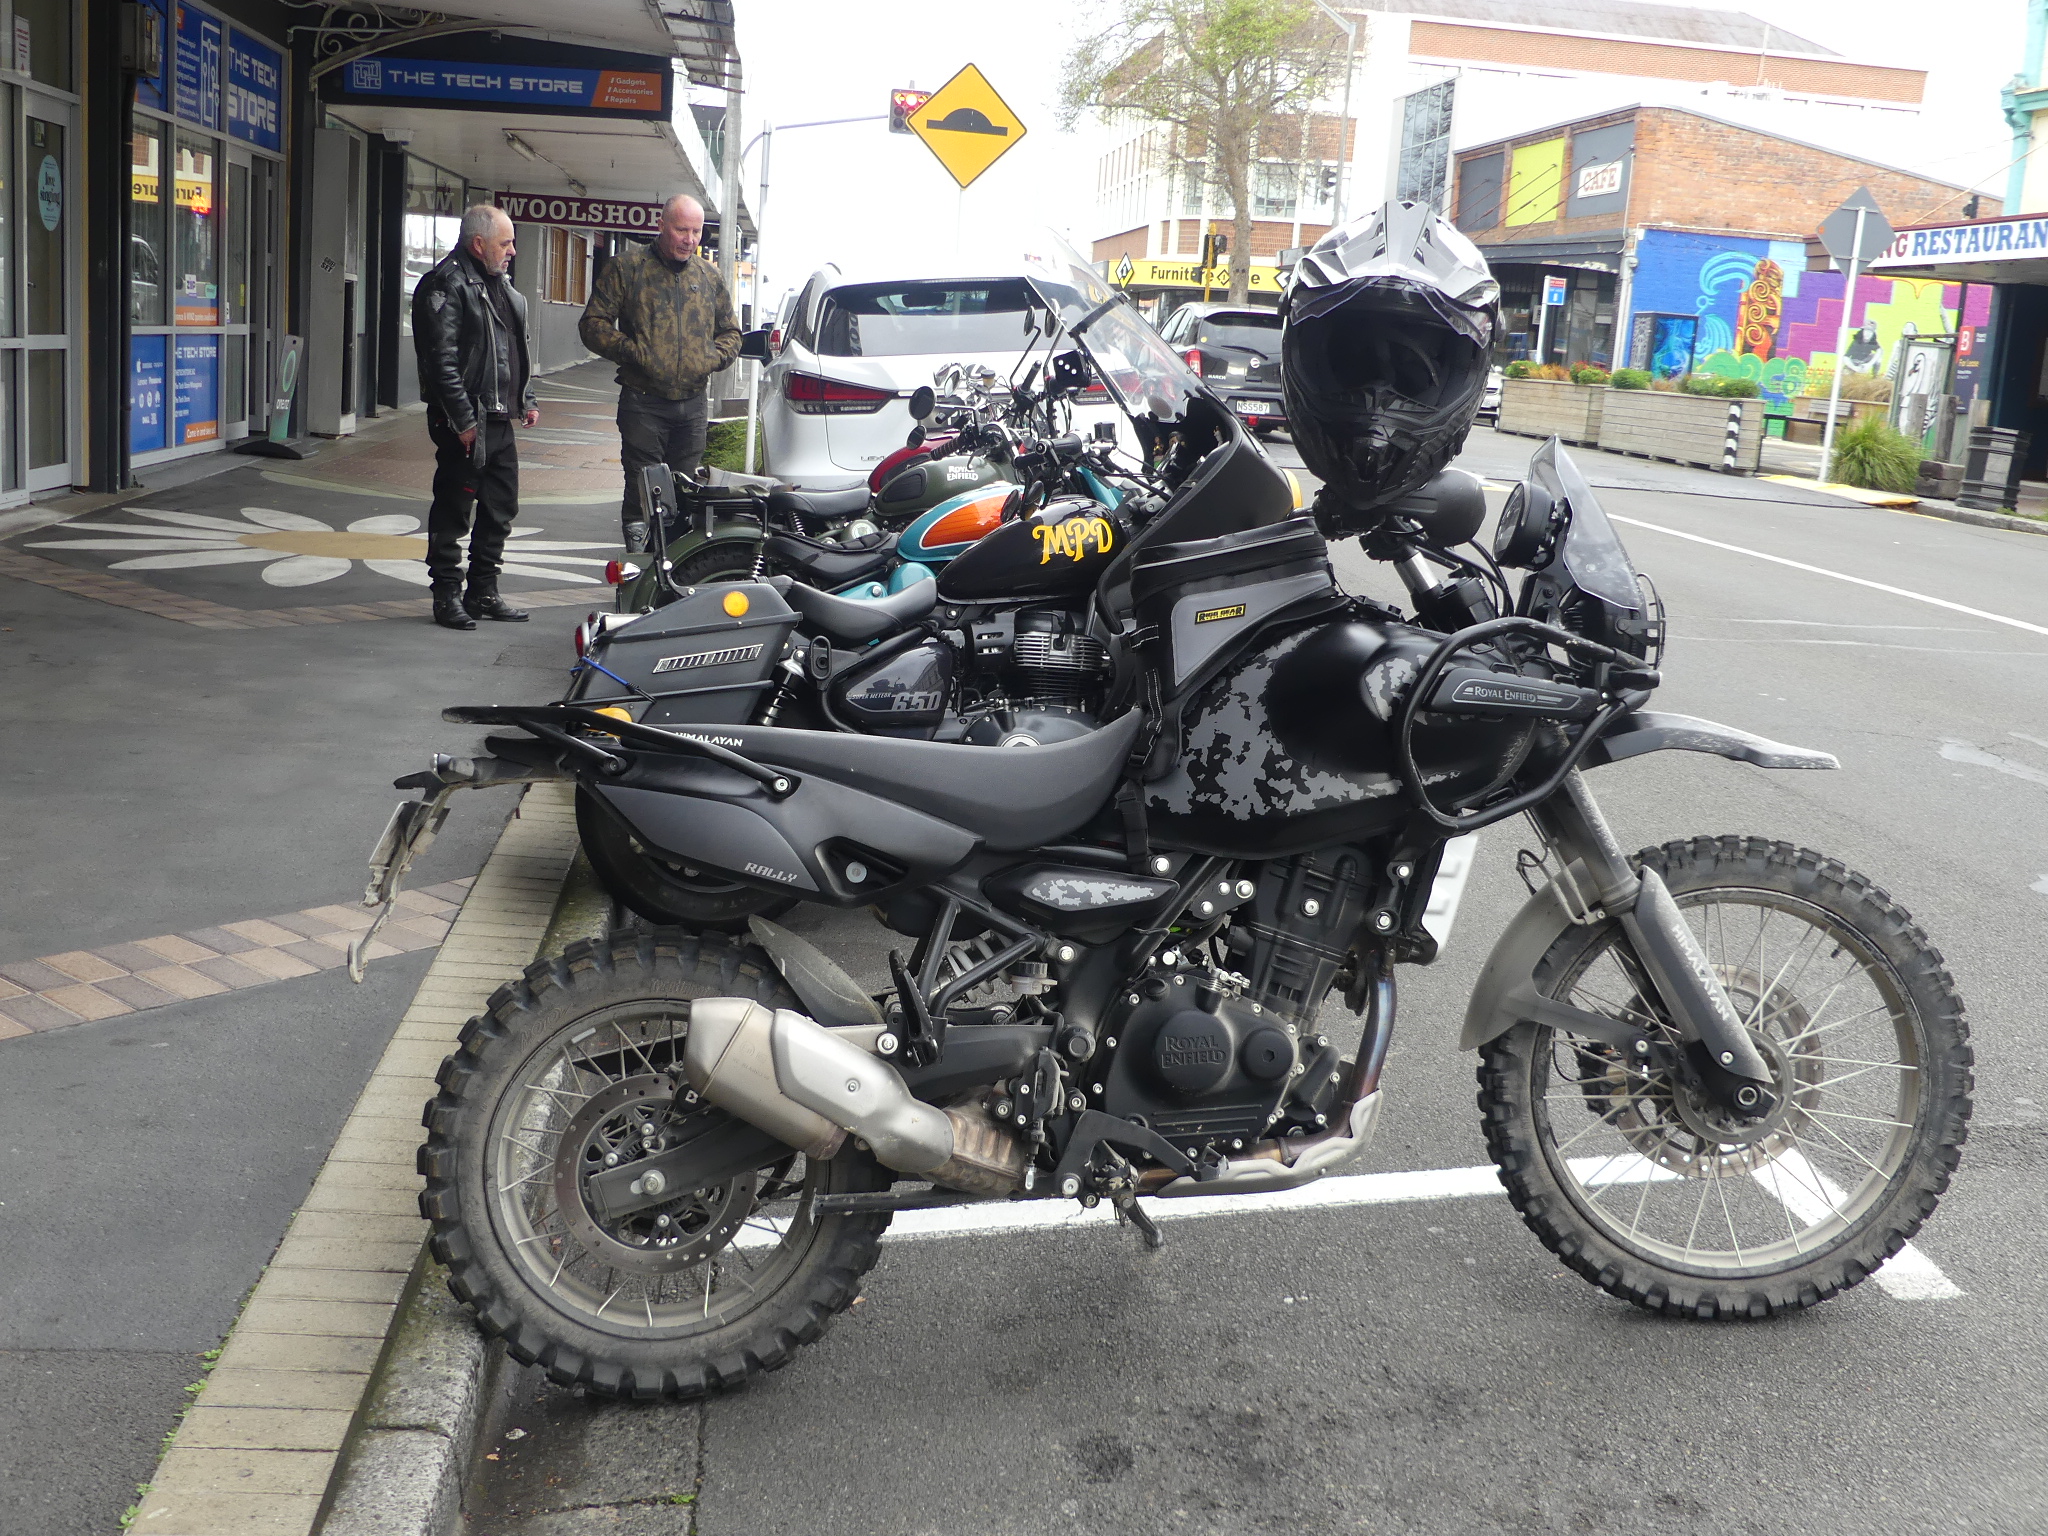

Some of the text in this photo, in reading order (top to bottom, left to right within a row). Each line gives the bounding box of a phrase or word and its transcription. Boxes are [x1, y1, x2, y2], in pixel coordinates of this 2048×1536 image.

[229, 46, 277, 90] THE TECH
[388, 70, 583, 94] THE TECH STORE
[616, 77, 646, 86] Gadgets
[610, 95, 637, 104] Repairs
[612, 86, 654, 96] Accessories
[228, 83, 276, 133] STORE
[1584, 168, 1617, 192] CAFE
[1960, 330, 1970, 351] B
[183, 347, 198, 358] TECH
[199, 346, 216, 358] STORE
[947, 471, 979, 481] ENFIELD
[949, 465, 975, 473] ROYAL
[891, 691, 942, 711] 650
[1475, 686, 1536, 702] ROYAL ENFIELD
[745, 862, 798, 882] RALLY
[1671, 923, 1730, 1021] HIMALAYAN
[1165, 1034, 1218, 1052] ROYAL
[1162, 1050, 1226, 1068] ENFIELD
